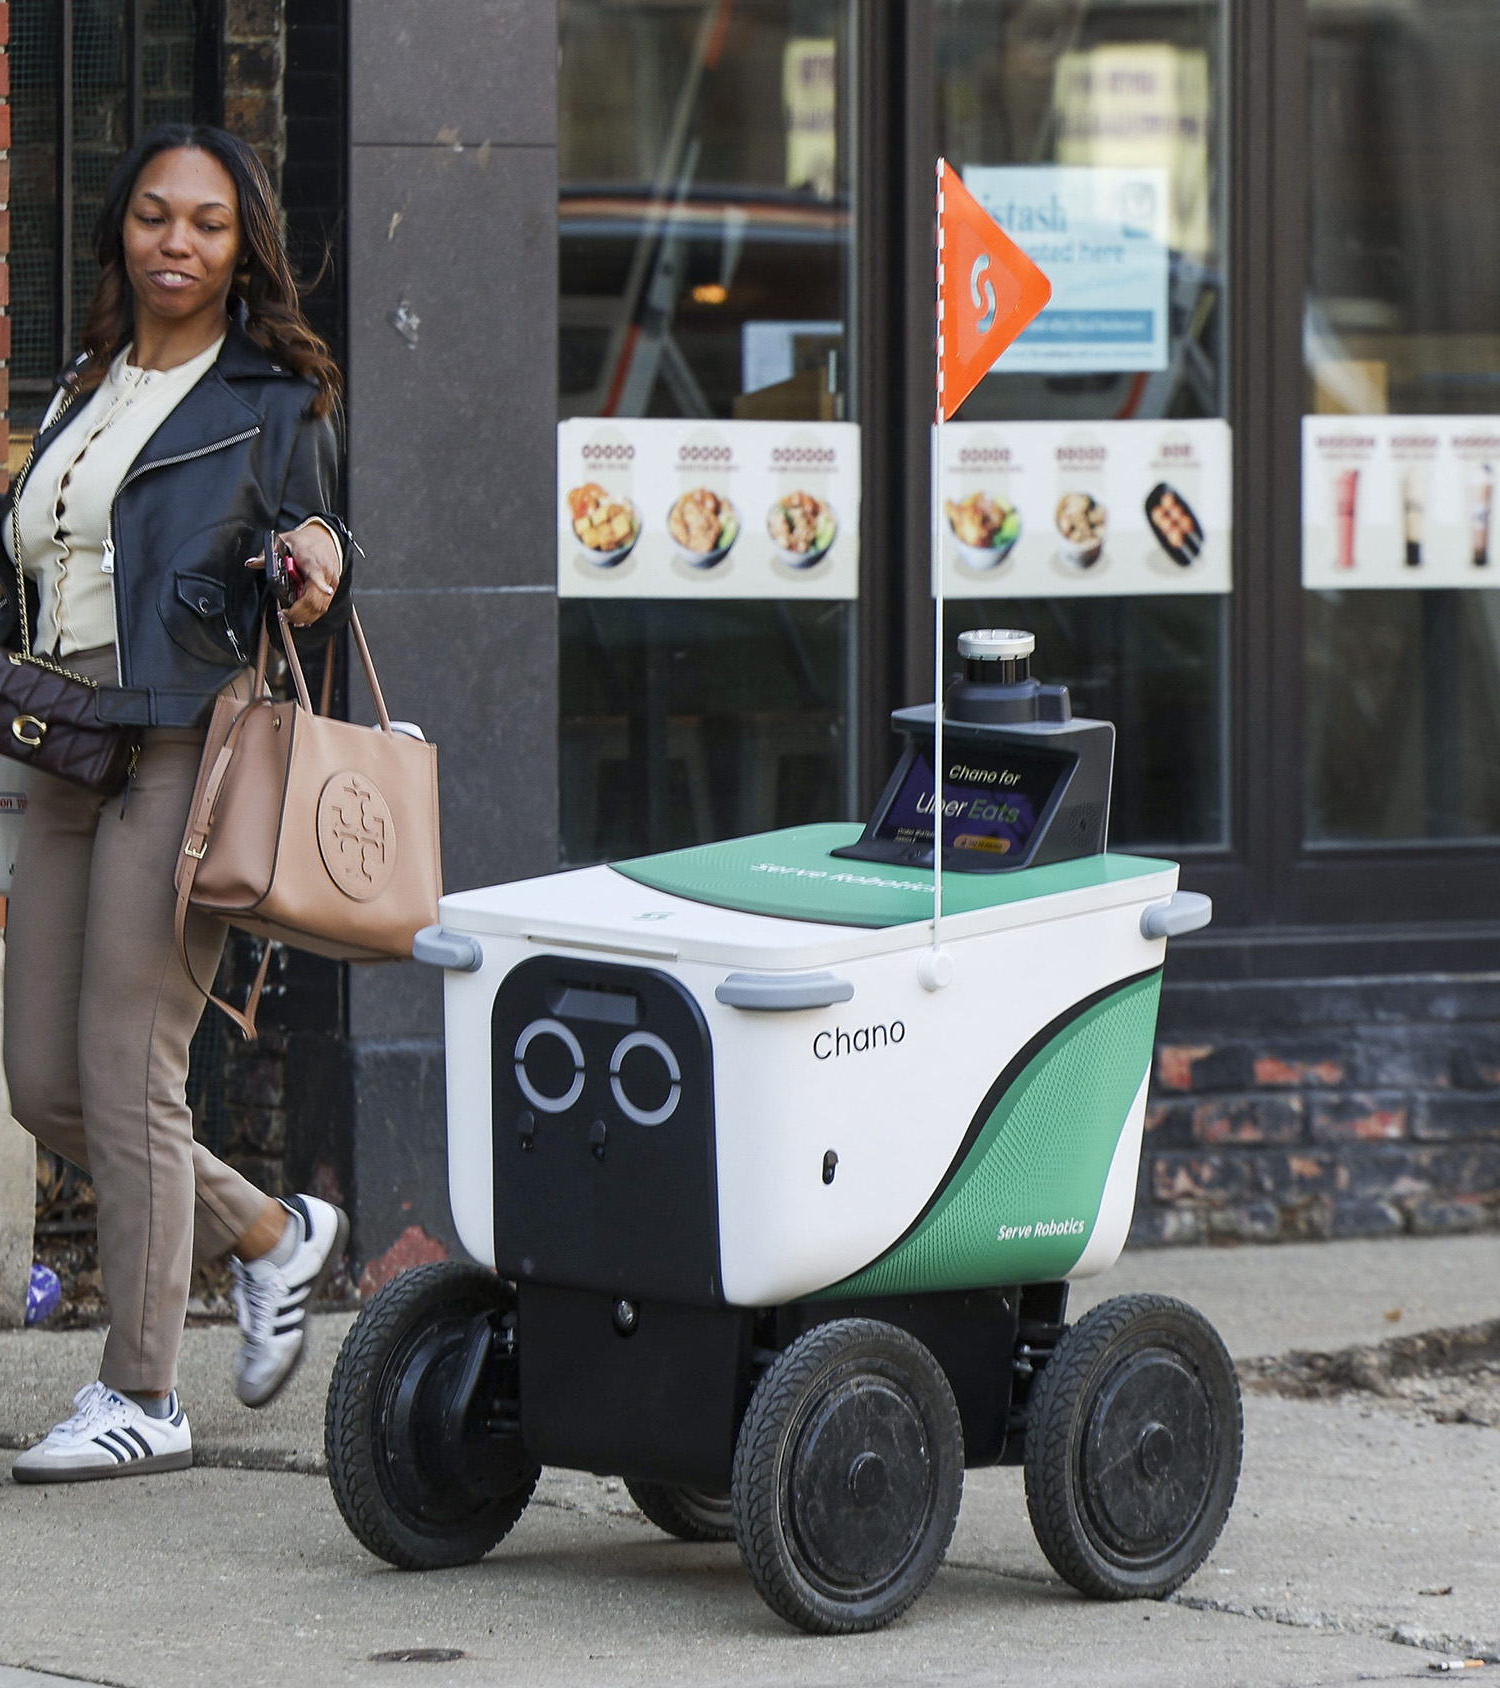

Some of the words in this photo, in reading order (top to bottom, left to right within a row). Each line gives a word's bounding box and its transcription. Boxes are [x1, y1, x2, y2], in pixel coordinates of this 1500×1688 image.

[1079, 241, 1125, 263] here
[949, 764, 997, 784] Chano
[998, 769, 1022, 786] for
[967, 798, 1020, 825] Eats
[750, 862, 828, 879] Serve
[813, 1020, 905, 1060] Chano
[997, 1224, 1033, 1241] Serve
[1033, 1217, 1085, 1238] Robotics
